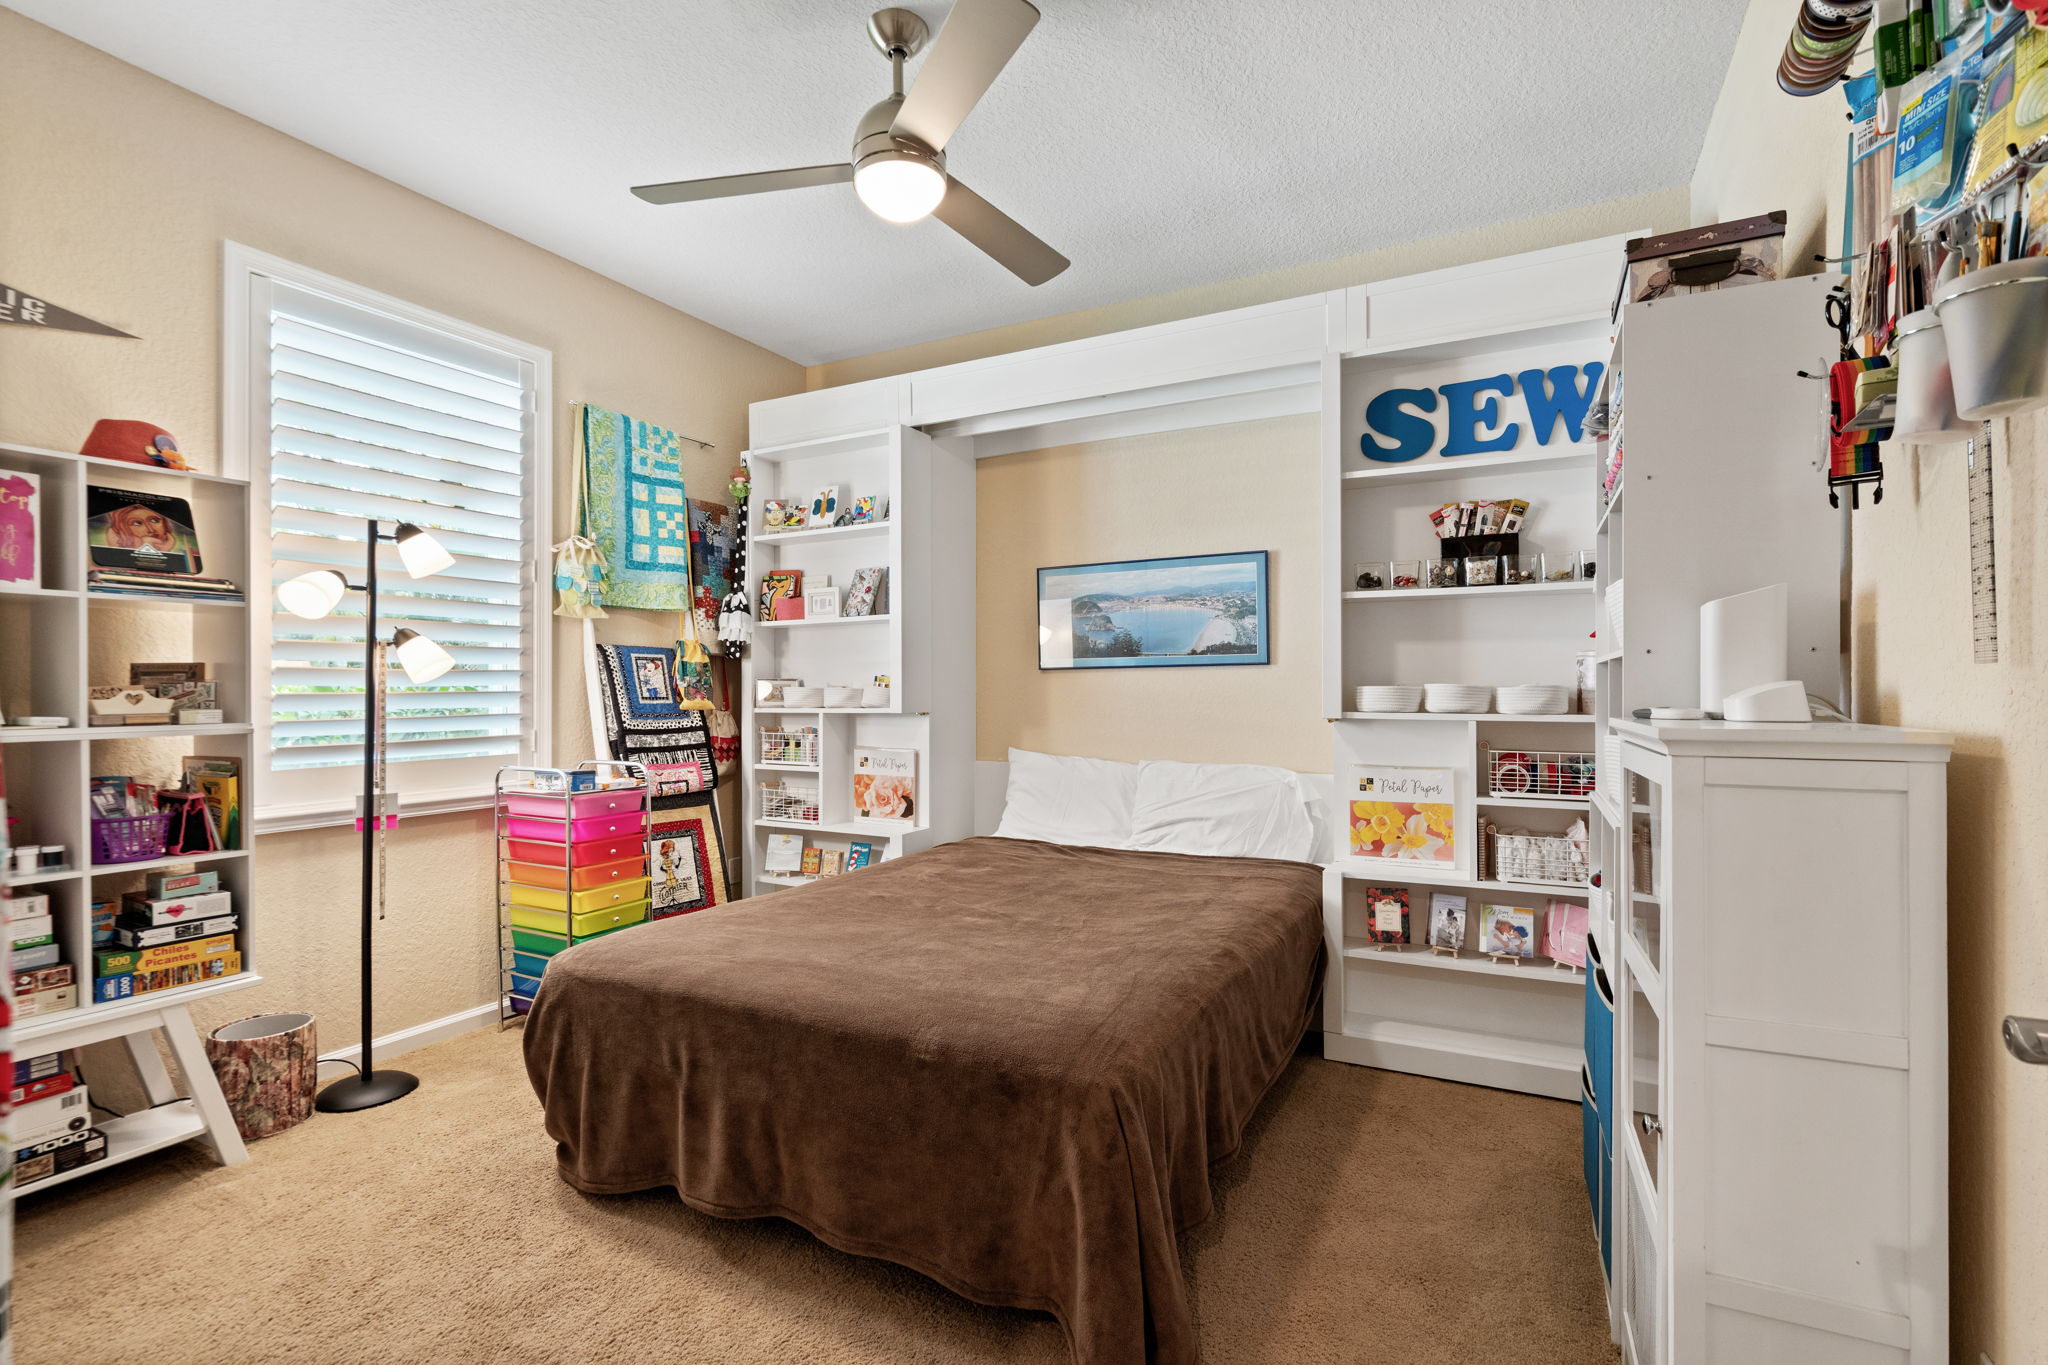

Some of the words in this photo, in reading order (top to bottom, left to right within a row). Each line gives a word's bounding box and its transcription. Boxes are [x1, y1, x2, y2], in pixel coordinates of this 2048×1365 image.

[1904, 101, 1927, 122] MINI
[1926, 87, 1947, 107] SIZE
[1899, 135, 1916, 155] 10
[1361, 361, 1604, 463] SEW
[1379, 778, 1407, 794] Petal
[1411, 779, 1442, 798] Paper
[15, 936, 46, 945] 1000
[107, 955, 131, 967] 500
[145, 952, 198, 967] Picantes
[153, 945, 190, 957] Chiles
[120, 976, 131, 995] 1000
[32, 1130, 89, 1154] 1000
